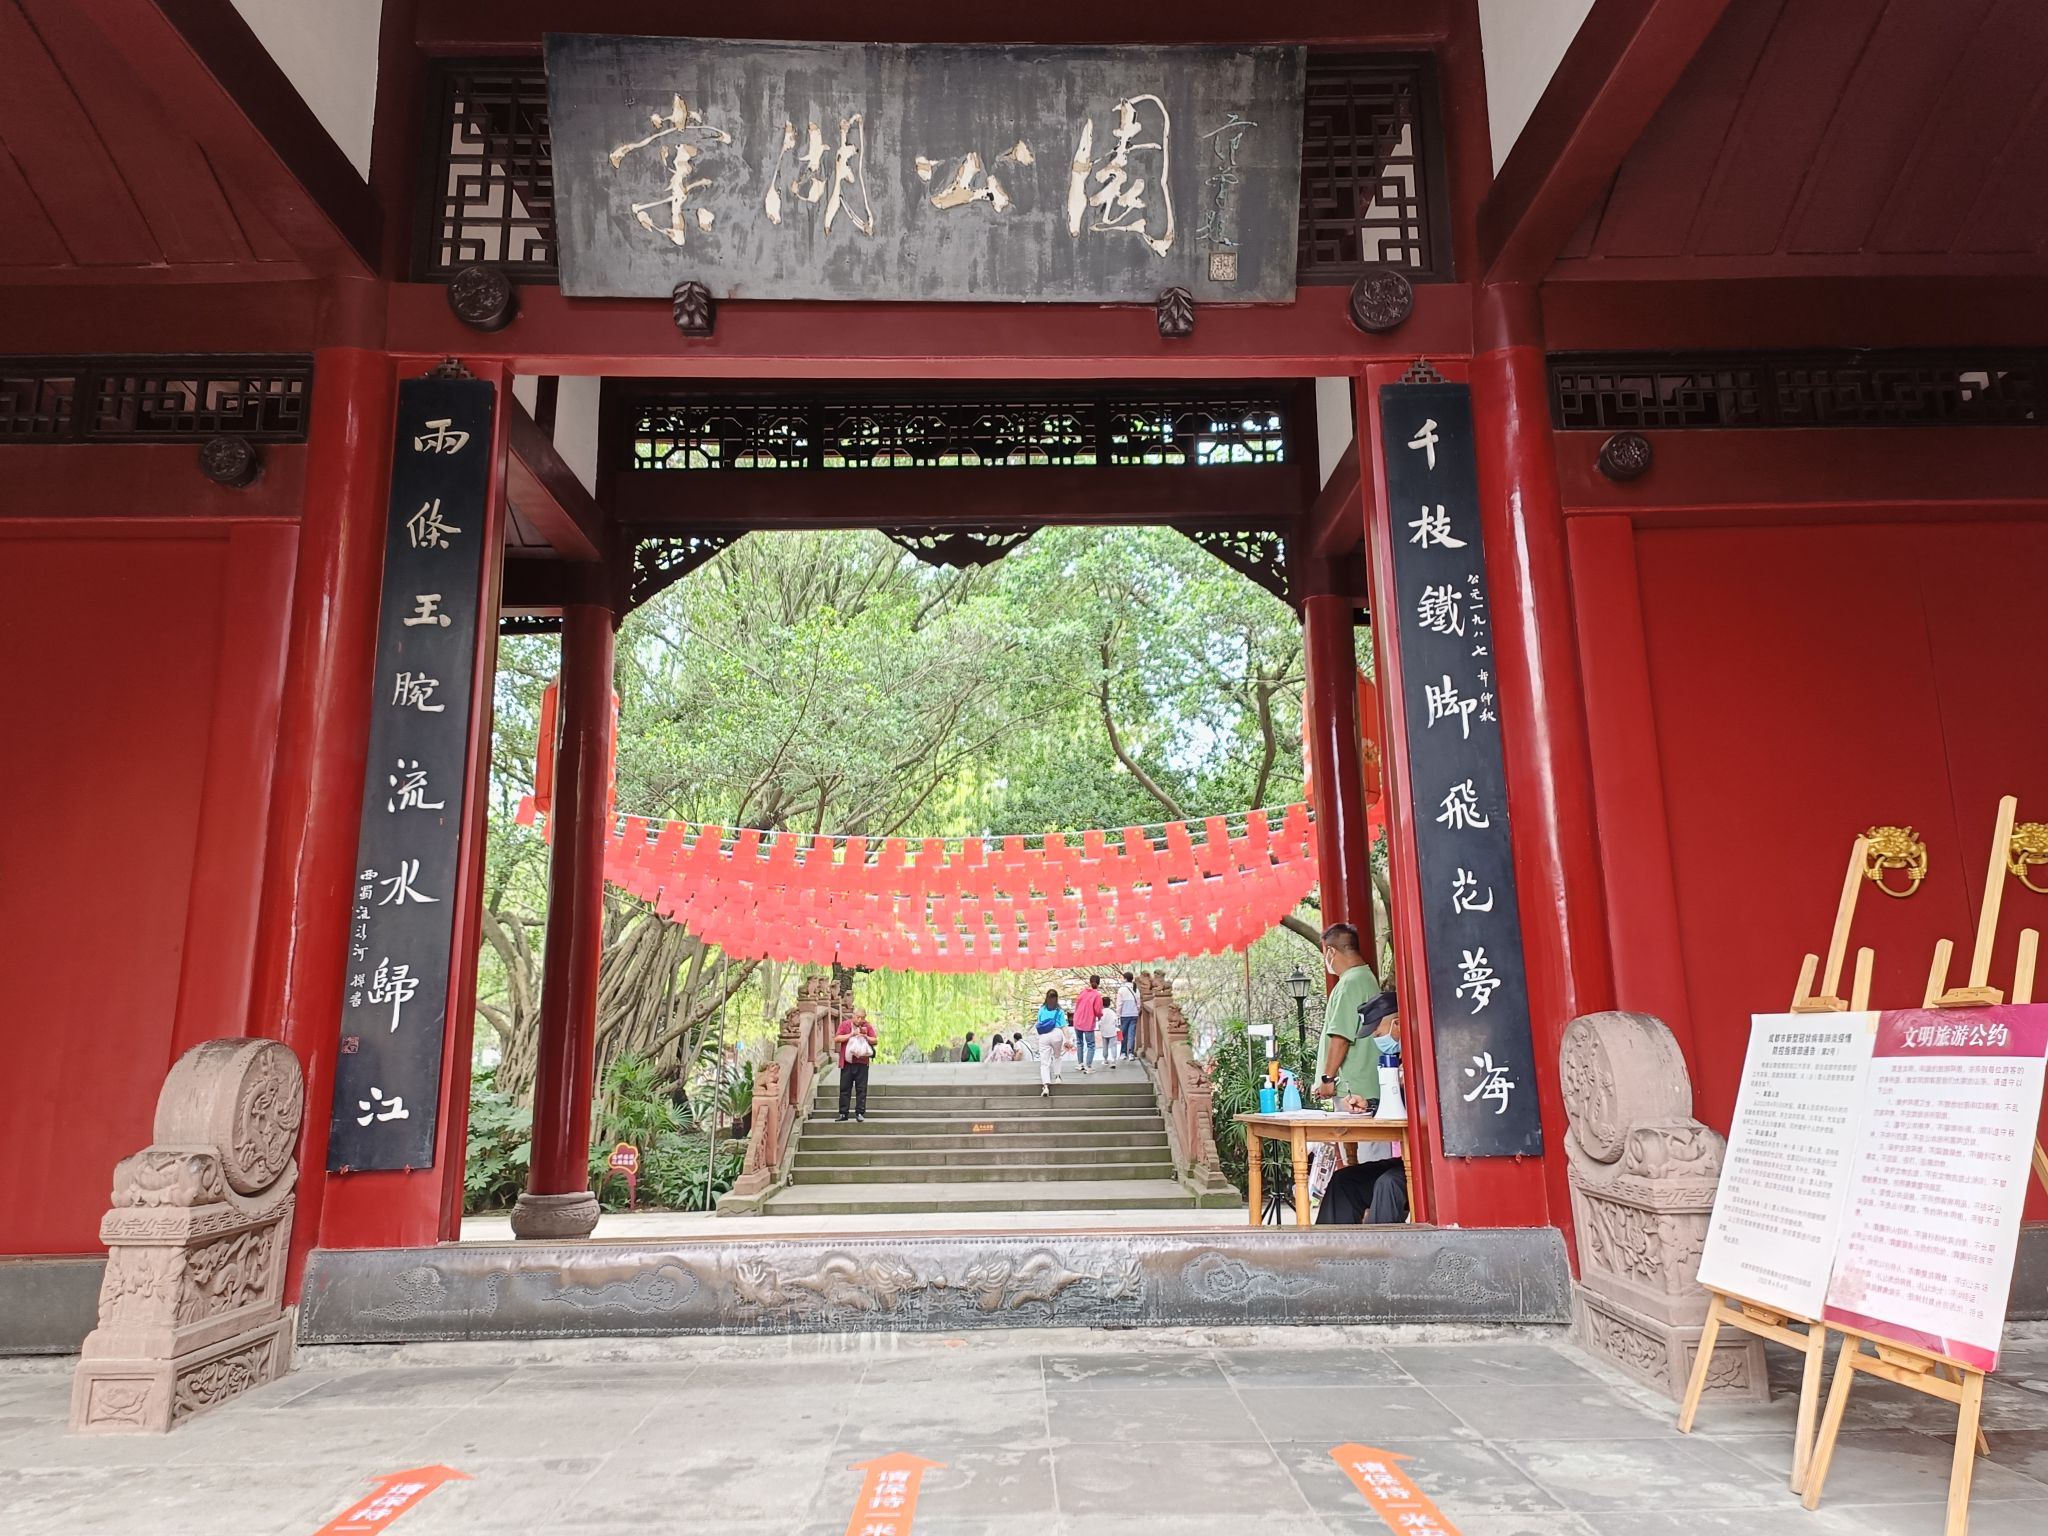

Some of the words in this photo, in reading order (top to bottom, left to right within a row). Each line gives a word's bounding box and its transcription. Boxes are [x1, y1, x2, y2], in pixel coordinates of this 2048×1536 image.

[1900, 1023, 2009, 1049] 文明旅游公约
